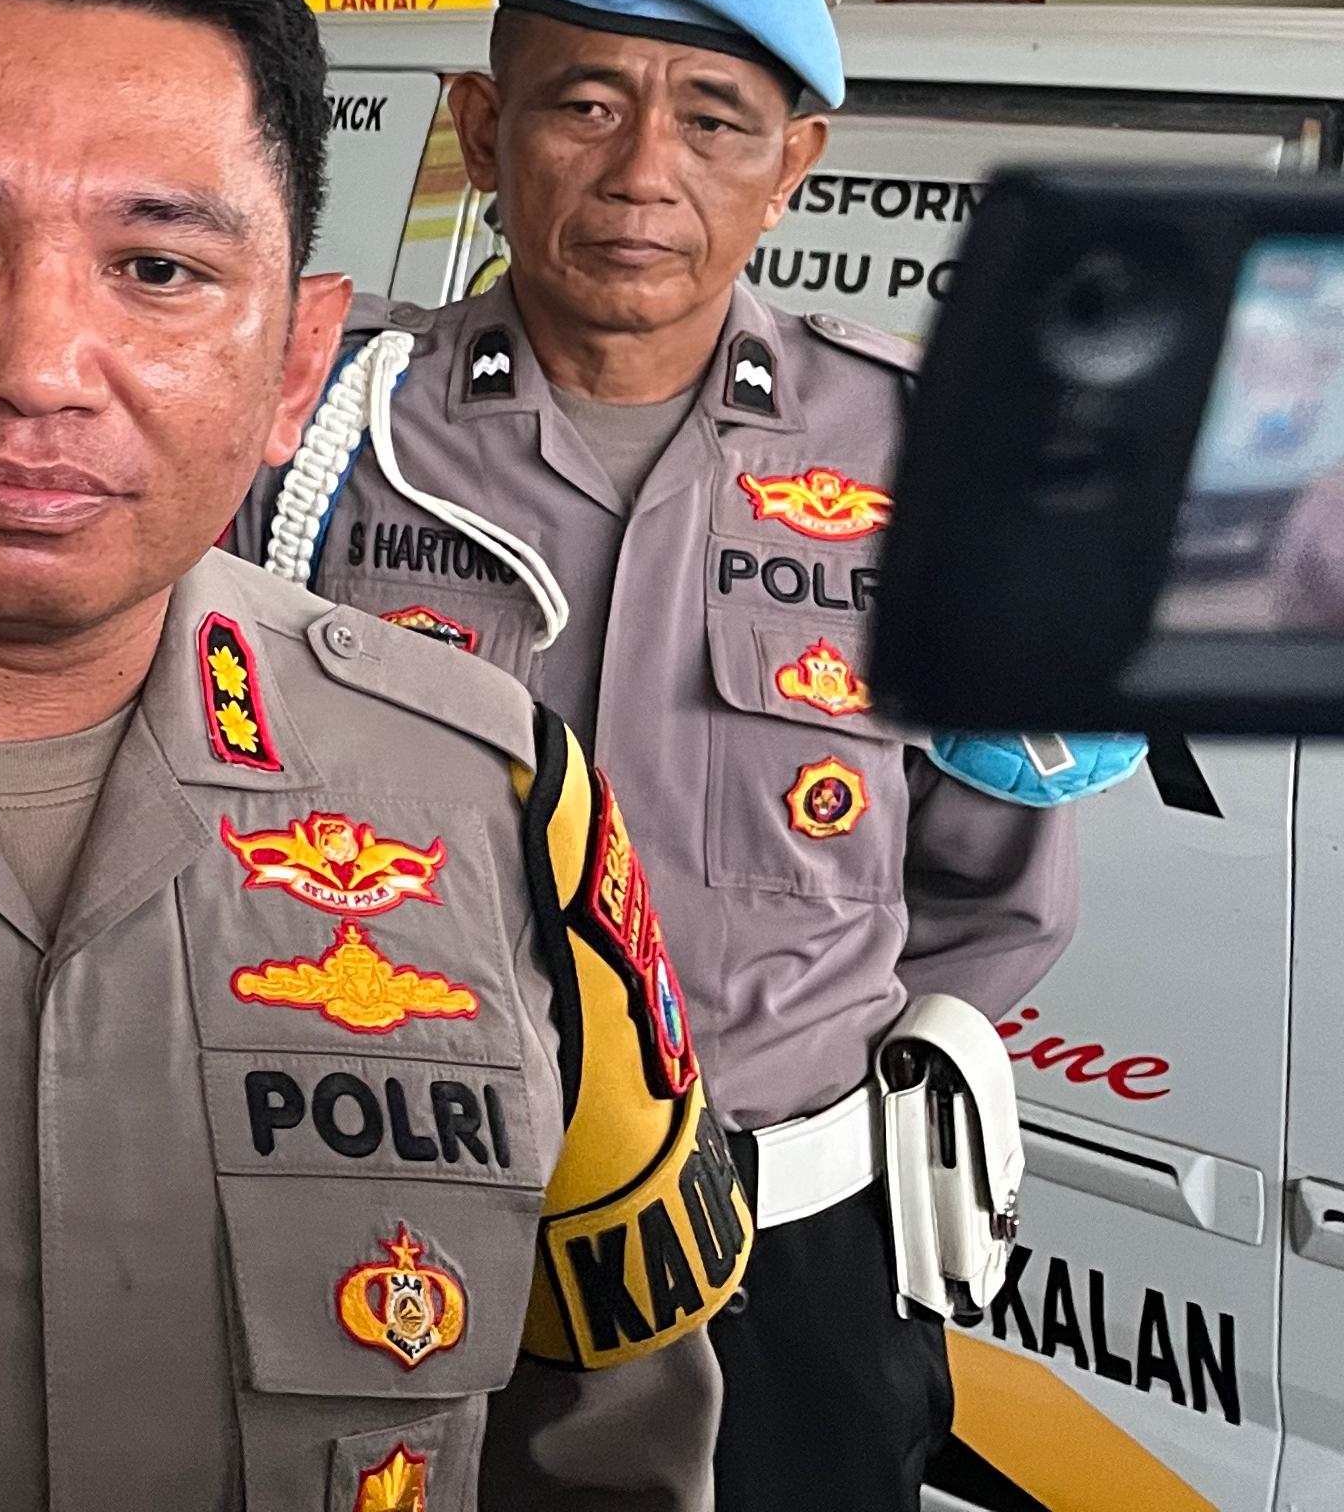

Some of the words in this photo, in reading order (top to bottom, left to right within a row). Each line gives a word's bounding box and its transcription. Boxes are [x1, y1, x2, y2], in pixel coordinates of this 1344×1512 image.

[329, 96, 388, 131] KCK
[348, 521, 366, 566] S
[245, 1070, 510, 1169] POLRI
